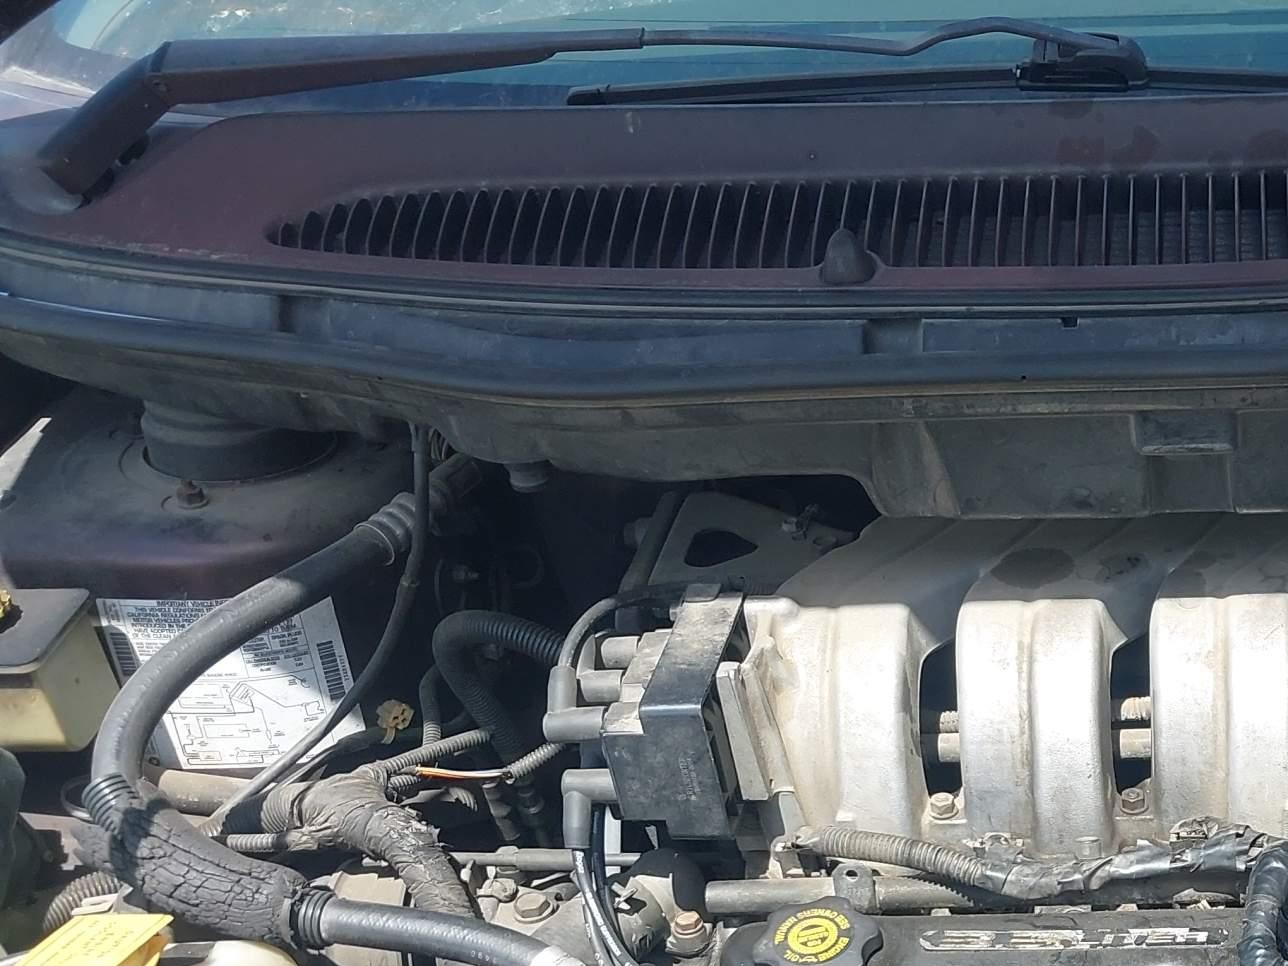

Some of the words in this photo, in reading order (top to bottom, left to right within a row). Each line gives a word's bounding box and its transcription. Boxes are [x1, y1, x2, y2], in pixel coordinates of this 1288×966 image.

[774, 916, 798, 945] MANUAL
[834, 914, 850, 930] SEE
[783, 949, 800, 962] OIL
[817, 936, 850, 962] ENGINE
